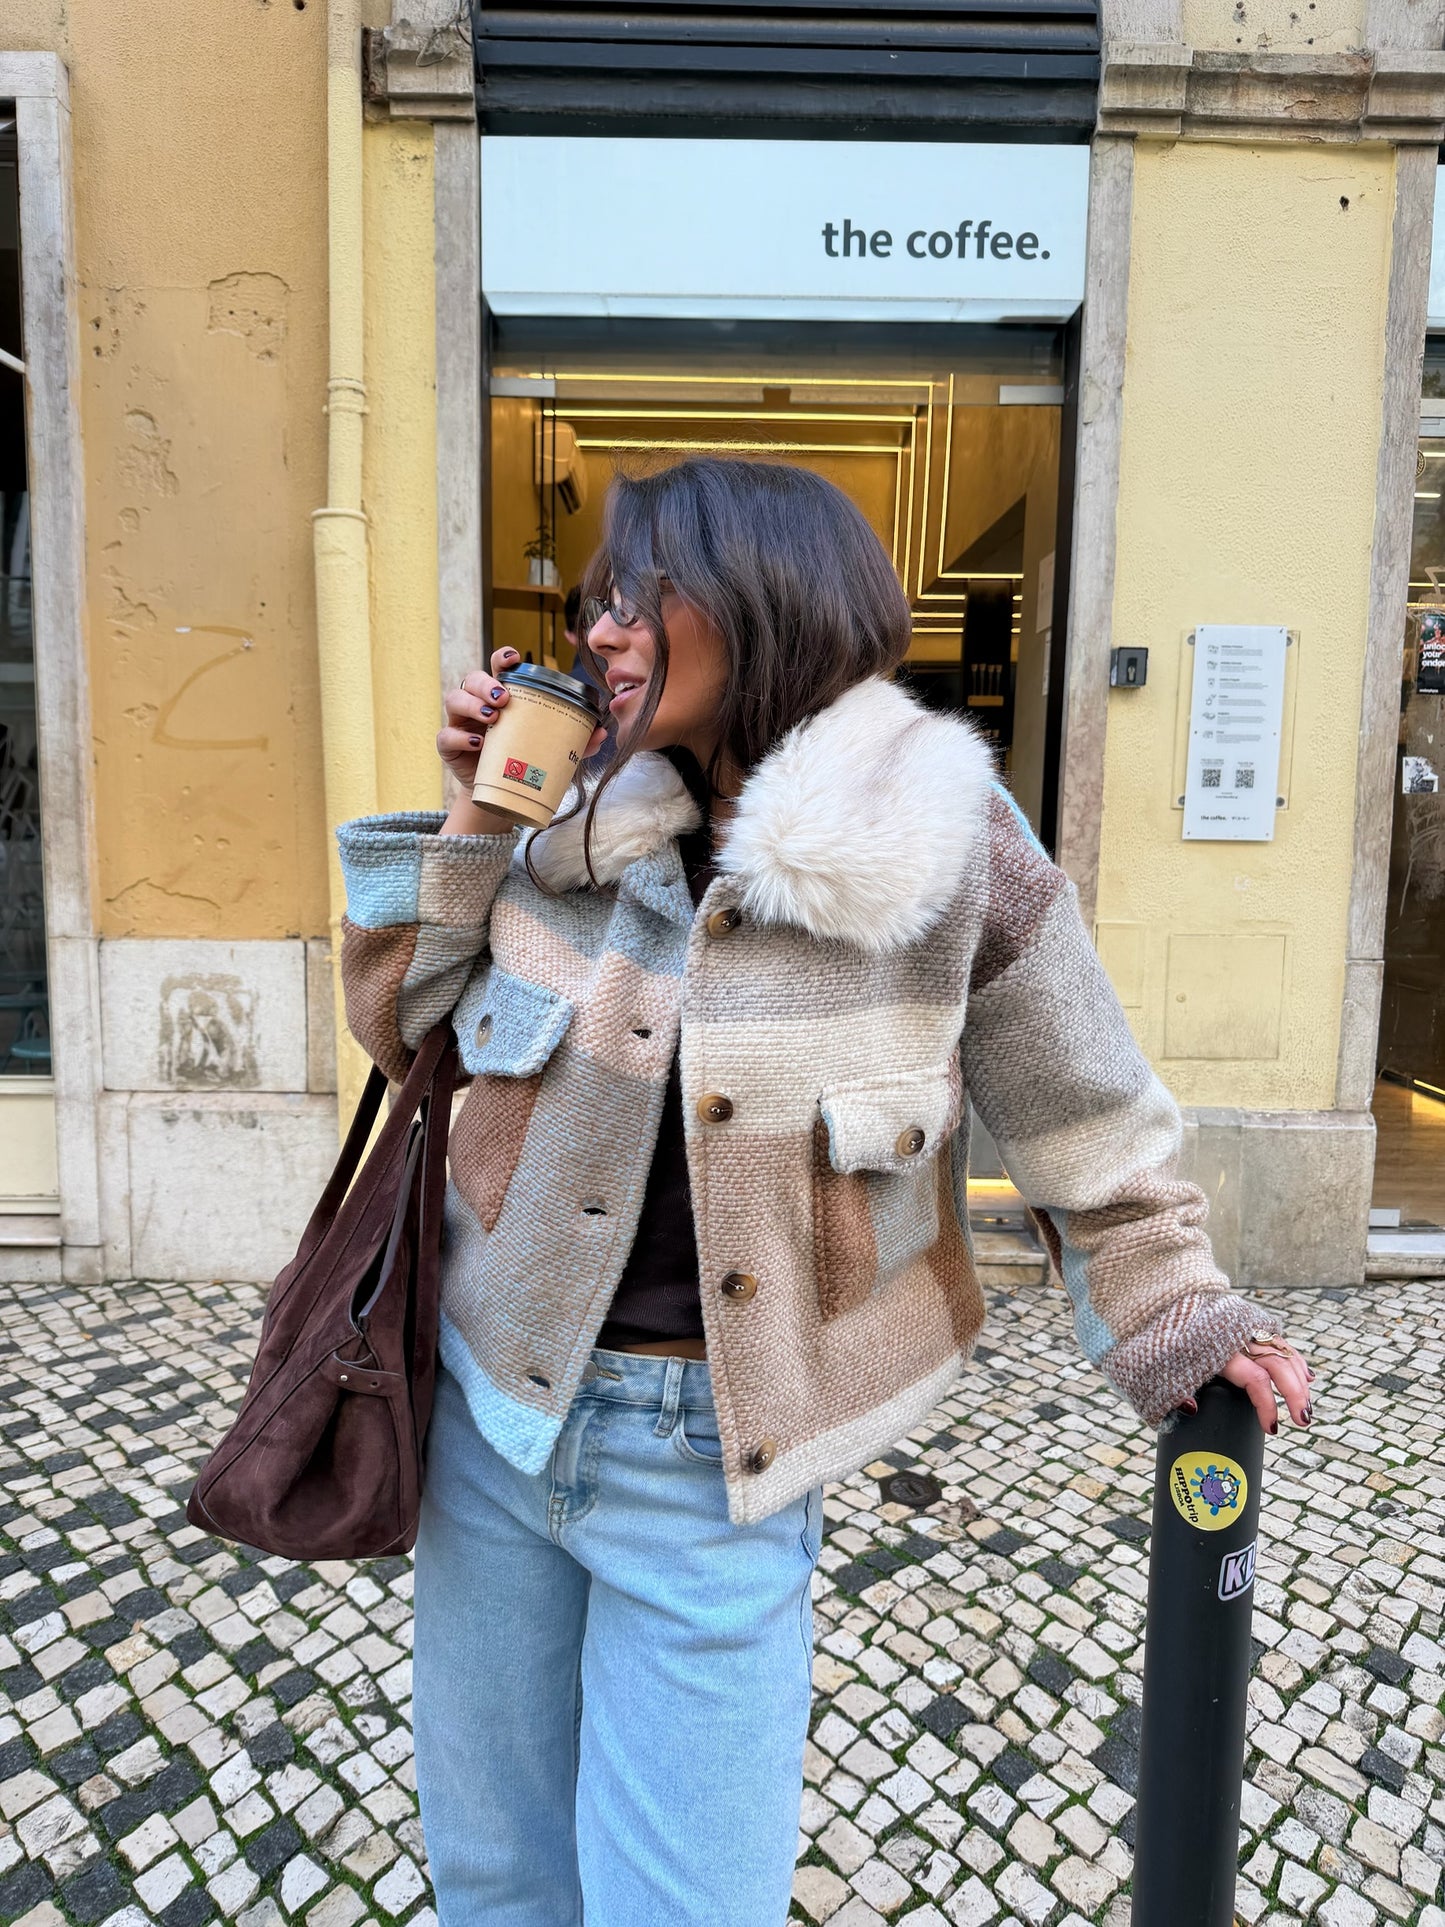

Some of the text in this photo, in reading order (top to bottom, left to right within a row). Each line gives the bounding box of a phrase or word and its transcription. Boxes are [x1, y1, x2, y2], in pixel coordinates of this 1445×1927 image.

[821, 218, 1051, 260] the coffee.
[1423, 642, 1445, 651] unloc
[1422, 651, 1442, 660] your
[568, 750, 580, 765] the
